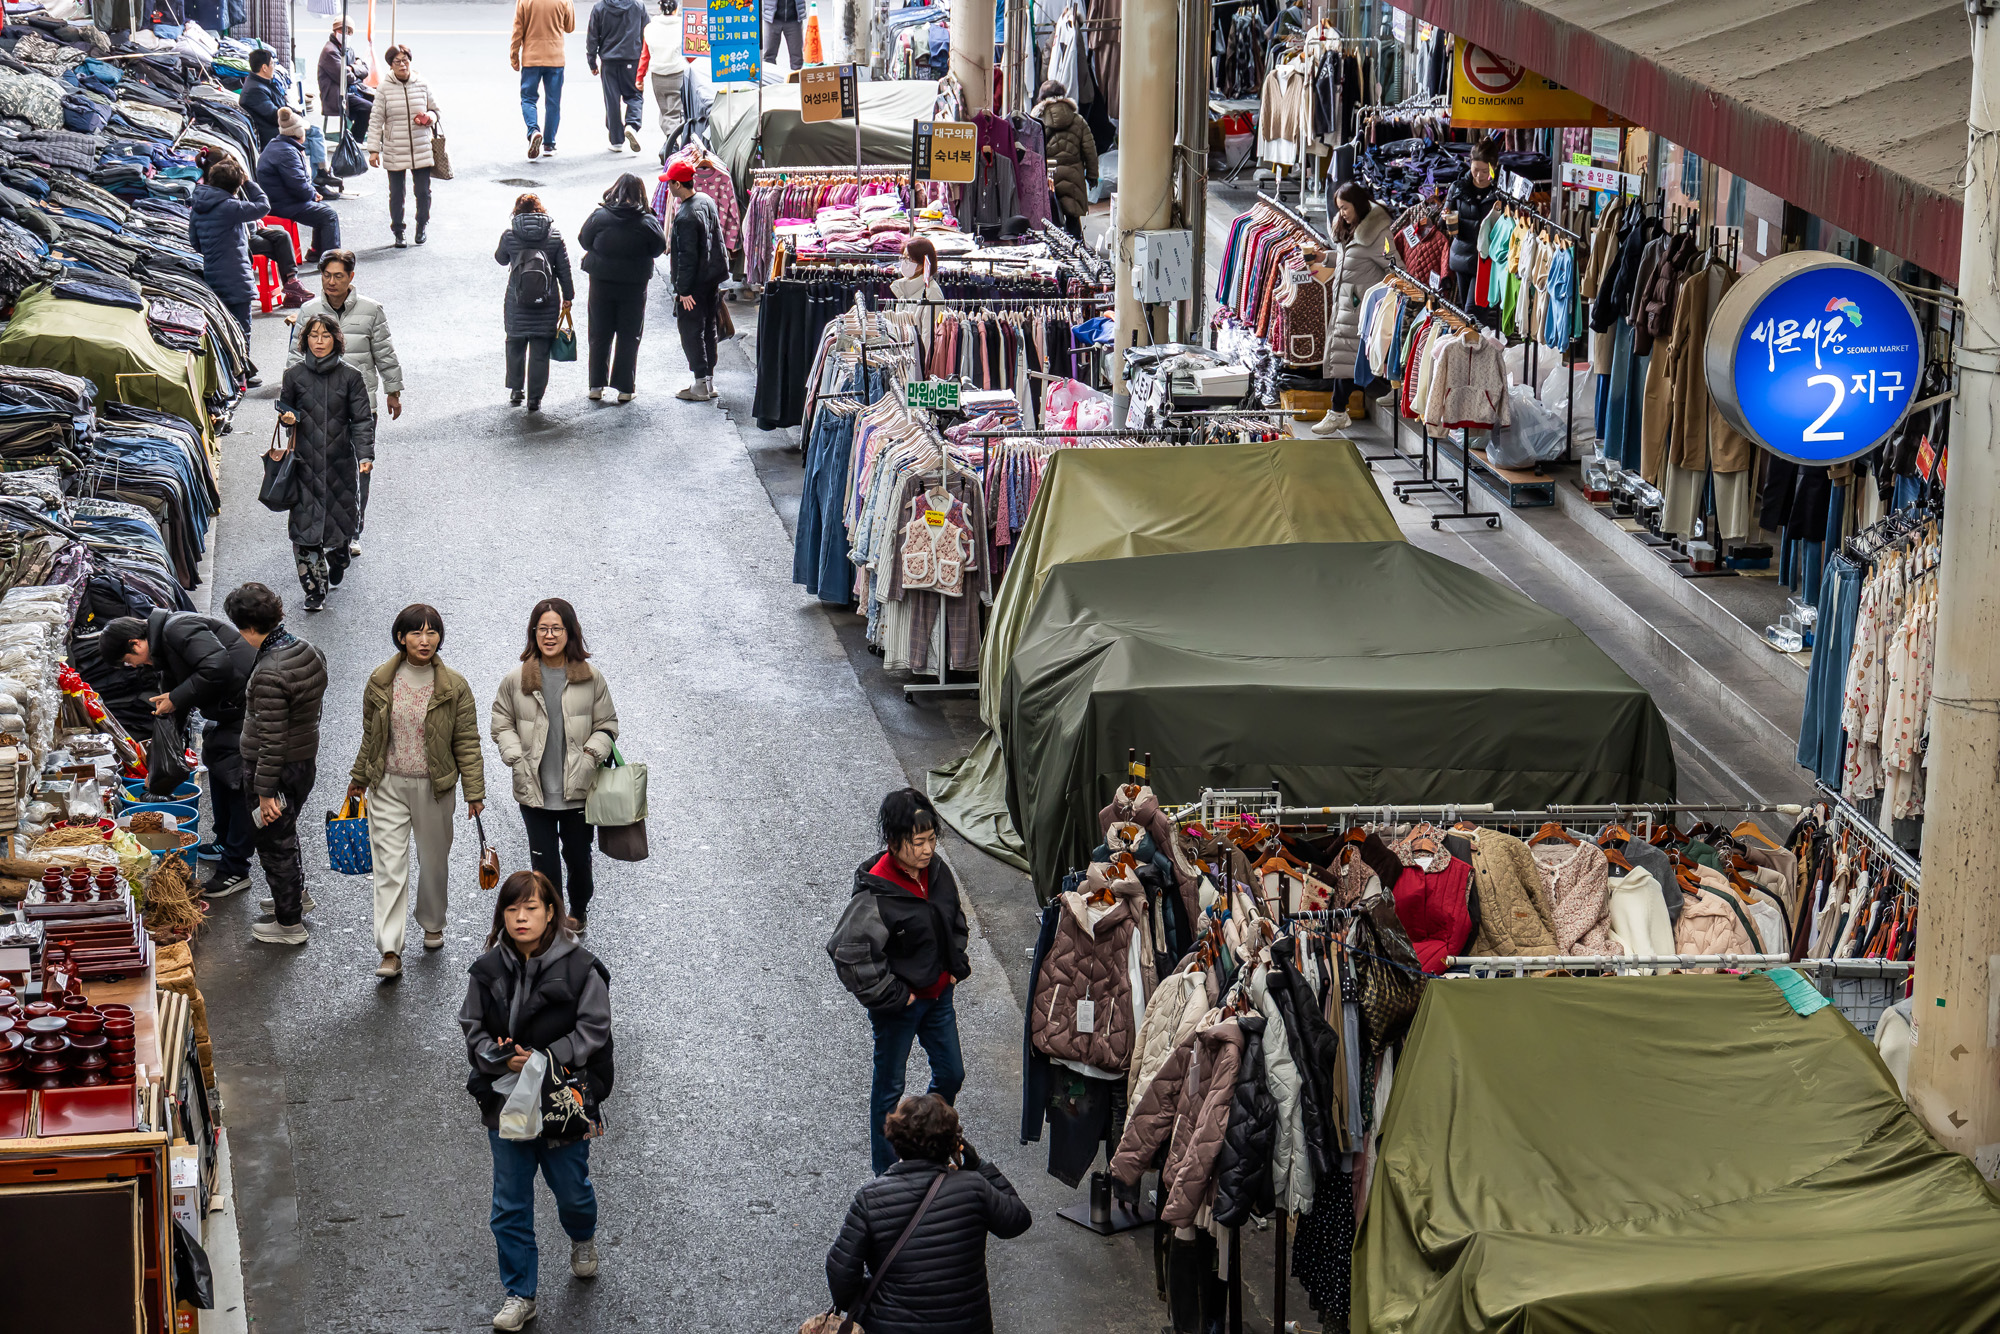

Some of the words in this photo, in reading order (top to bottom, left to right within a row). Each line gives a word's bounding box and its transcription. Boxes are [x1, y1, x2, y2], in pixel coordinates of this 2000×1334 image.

[806, 71, 835, 83] 큰옷집
[804, 91, 840, 105] 여성의류
[1461, 96, 1476, 105] NO
[1478, 96, 1524, 106] SMOKING
[934, 128, 975, 139] 대구의류
[934, 149, 972, 163] 숙녀복
[1587, 169, 1614, 185] 출입문
[1750, 316, 1847, 372] 서문시장
[1846, 346, 1878, 355] SEOMUN
[1879, 345, 1909, 353] MARKET
